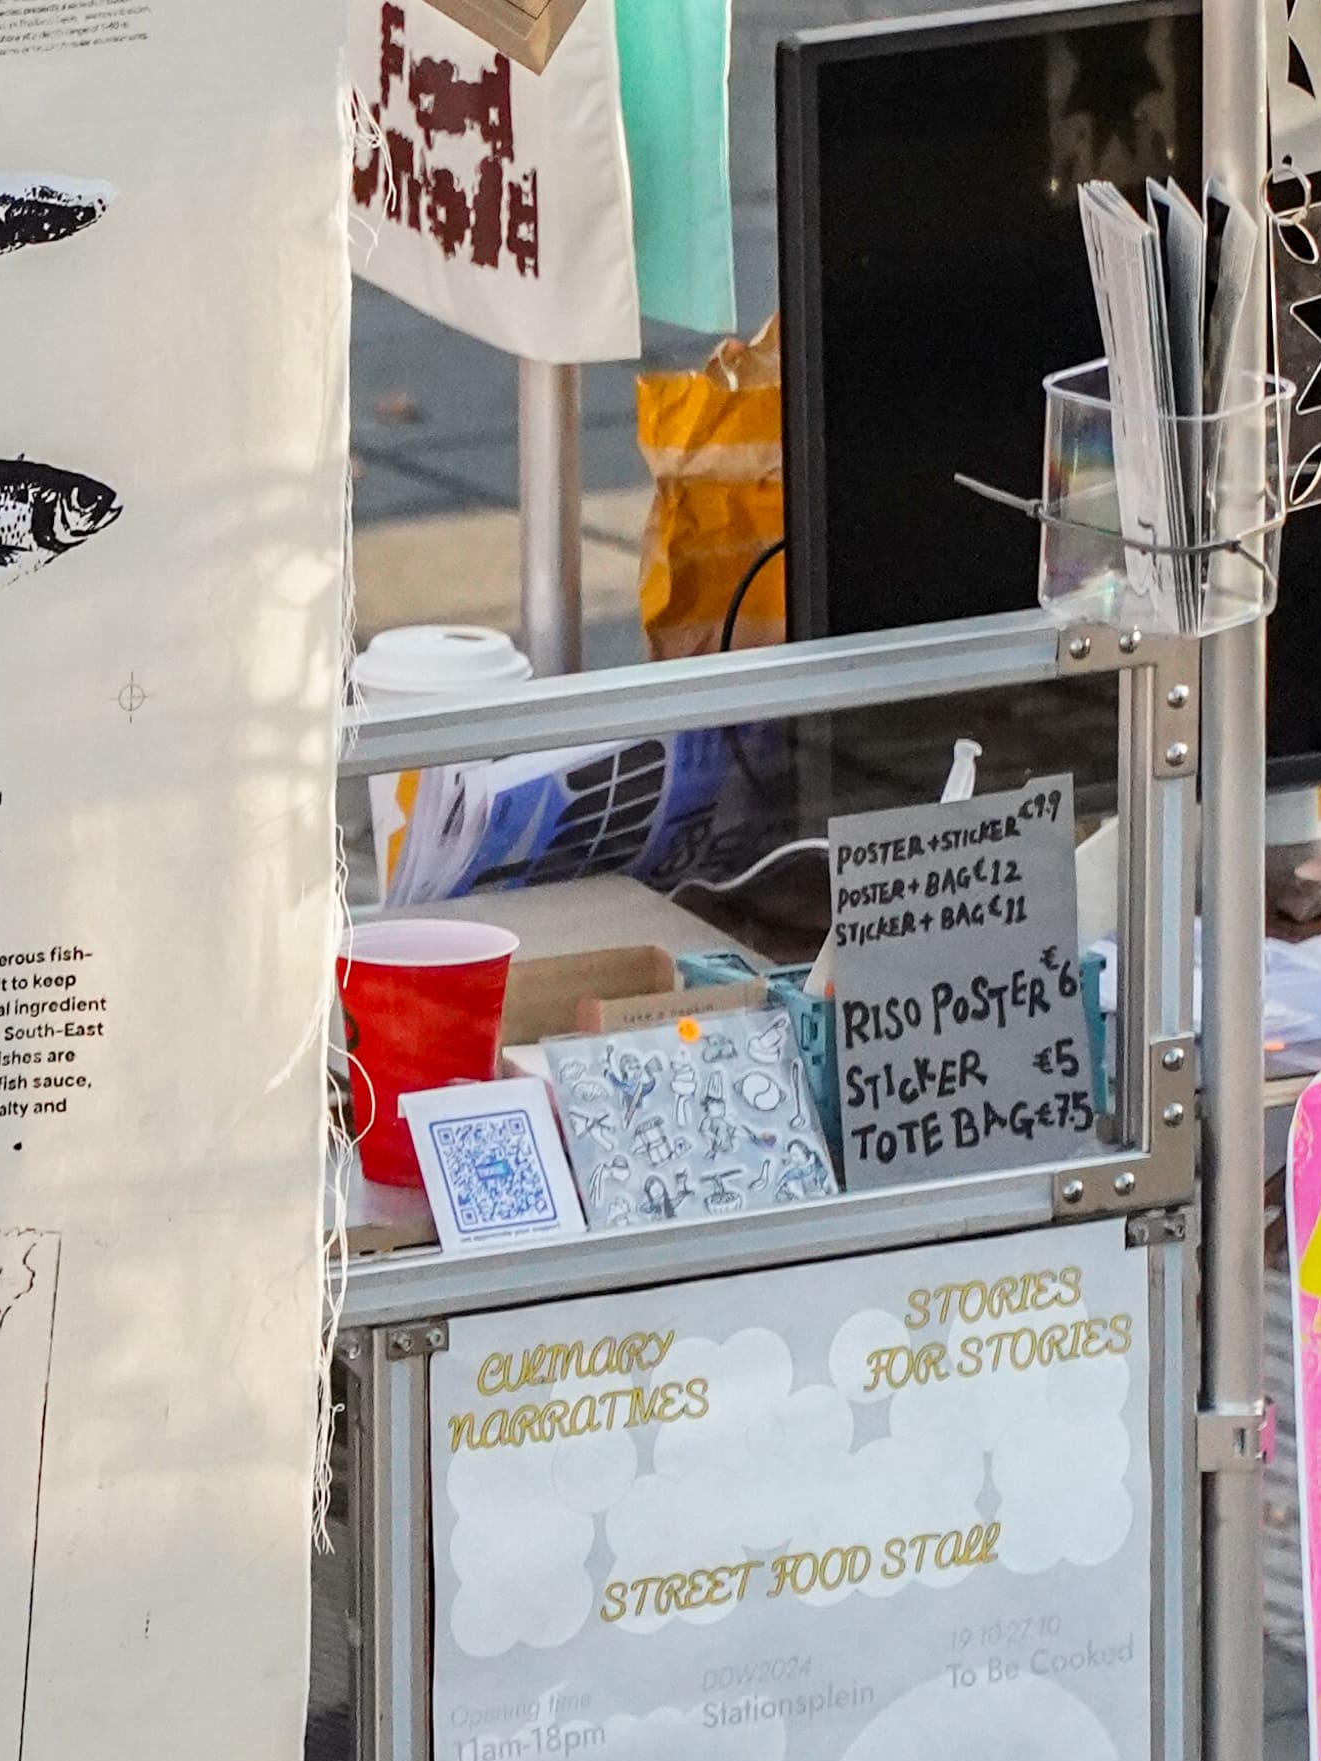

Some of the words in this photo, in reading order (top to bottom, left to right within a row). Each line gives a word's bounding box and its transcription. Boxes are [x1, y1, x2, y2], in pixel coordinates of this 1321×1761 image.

[925, 867, 971, 897] BAG
[941, 902, 984, 929] BAG
[50, 945, 93, 963] fish-
[843, 998, 921, 1049] RISO
[931, 970, 1051, 1035] POSTER
[846, 1050, 988, 1109] STICKER
[1033, 1038, 1079, 1077] €5
[851, 1112, 943, 1163] TOTE
[951, 1101, 1034, 1148] BAG
[906, 1267, 1083, 1330] STORIES
[864, 1342, 947, 1394] FOR
[958, 1314, 1132, 1378] STORIES
[601, 1561, 765, 1623] STREET
[765, 1549, 871, 1599] FOOD
[702, 1655, 813, 1692] DDW2024
[946, 1661, 975, 1690] To
[987, 1656, 1020, 1685] Be
[1031, 1635, 1134, 1678] Cooked
[451, 1696, 541, 1729] Opening
[549, 1689, 591, 1716] time
[703, 1682, 875, 1732] Stationsplein
